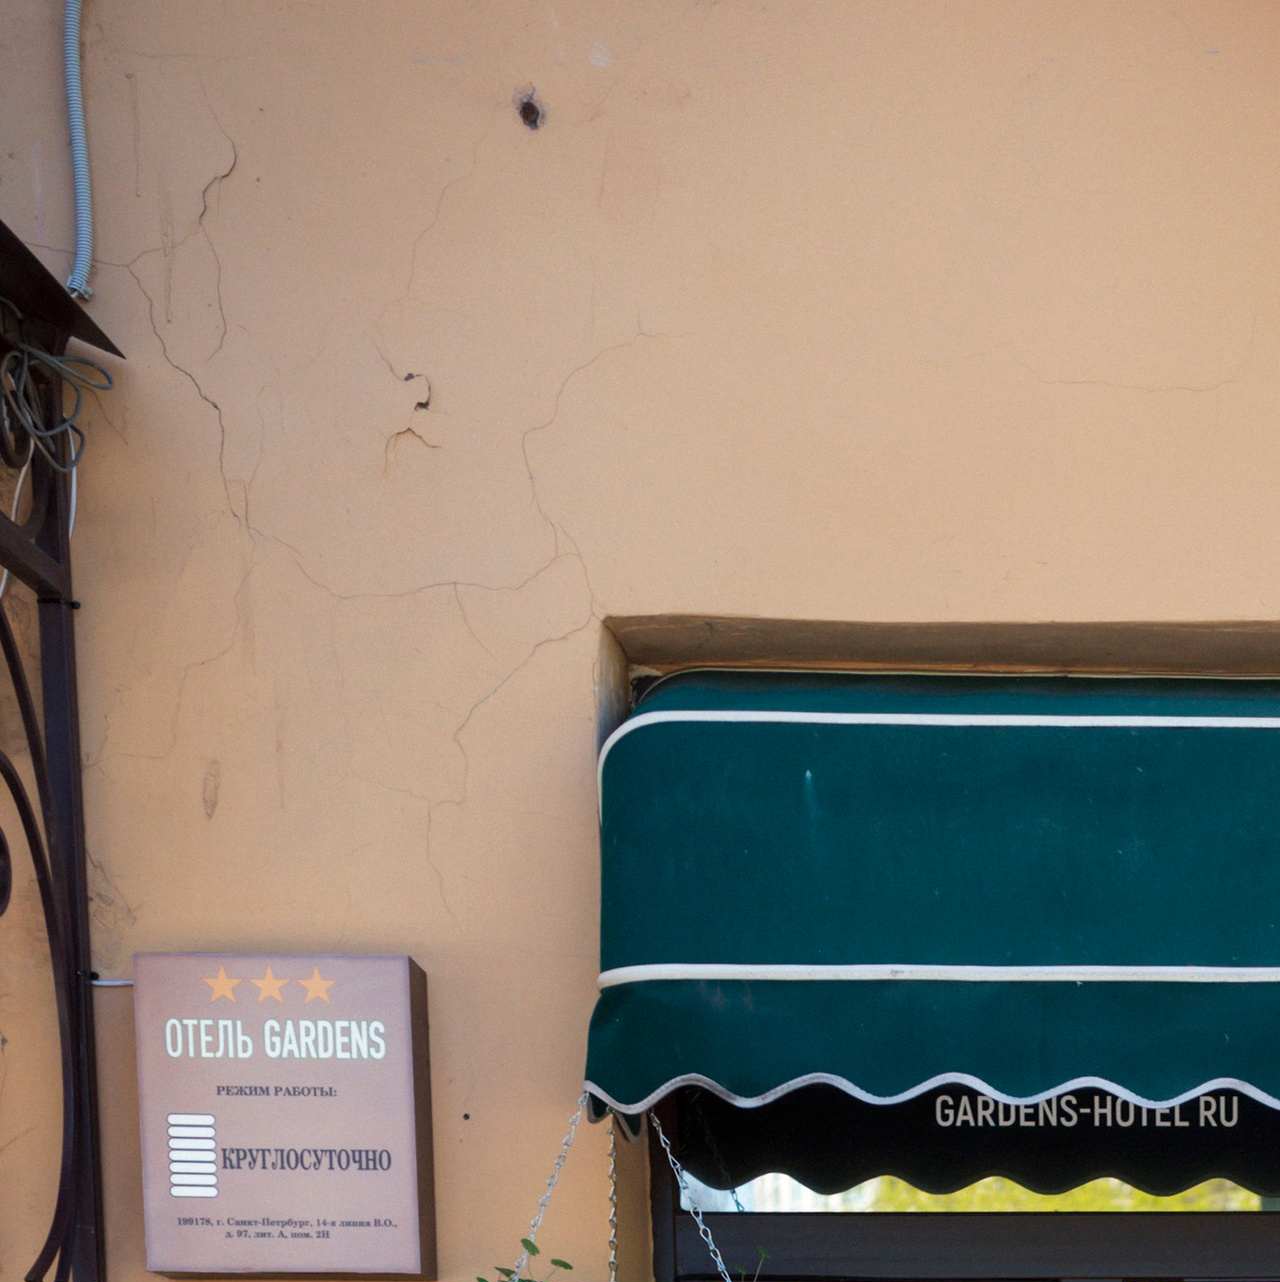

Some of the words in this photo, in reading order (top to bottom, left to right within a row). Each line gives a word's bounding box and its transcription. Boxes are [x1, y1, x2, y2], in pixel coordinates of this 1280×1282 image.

[164, 1018, 253, 1058] ОТЕЛЬ
[263, 1019, 386, 1060] GARDENS
[216, 1085, 270, 1097] РЕЖИМ
[273, 1086, 338, 1097] РАБОТЫ:
[221, 1147, 392, 1171] КРУГЛОСУТОЧНО
